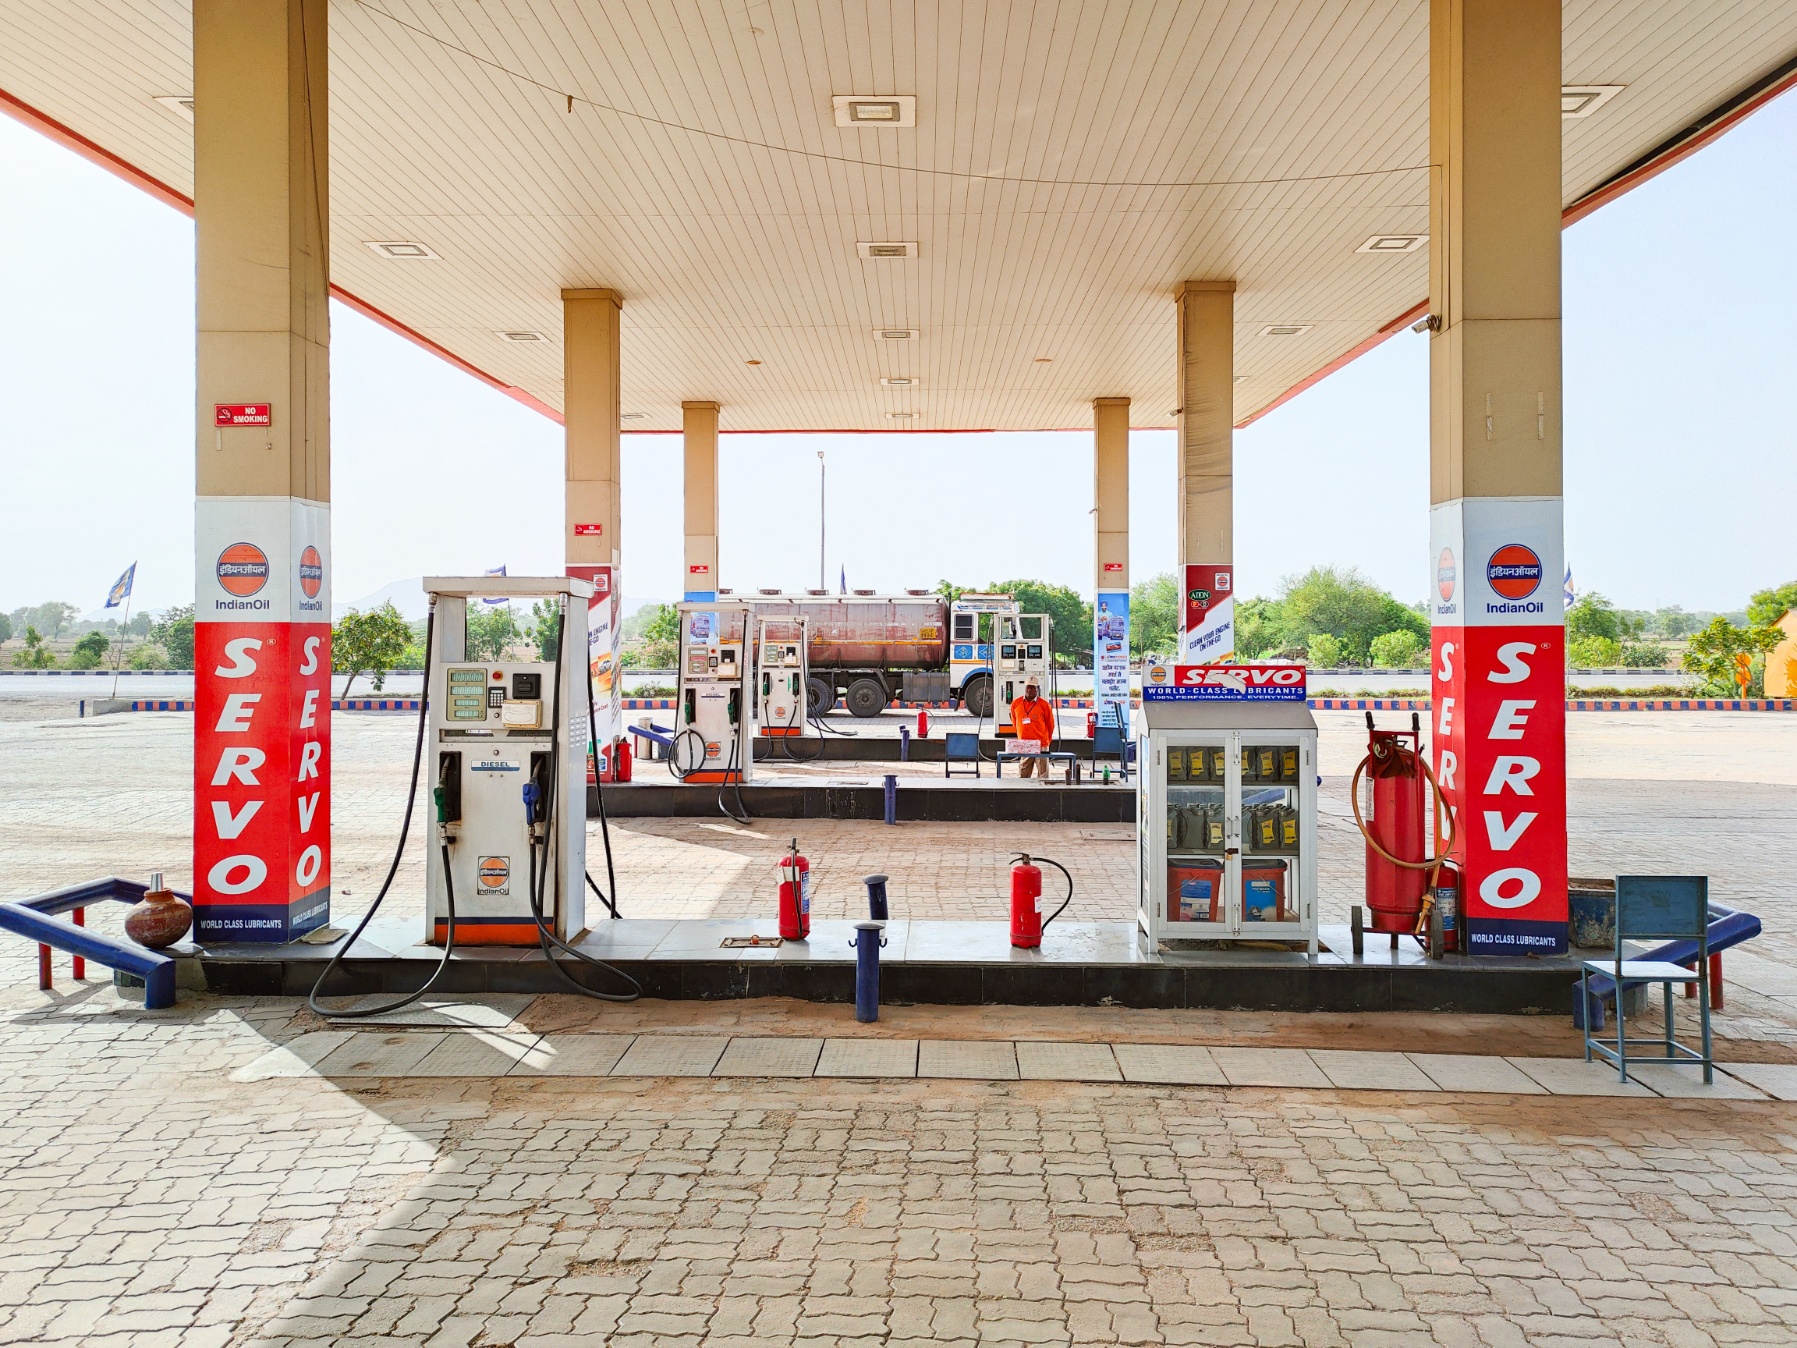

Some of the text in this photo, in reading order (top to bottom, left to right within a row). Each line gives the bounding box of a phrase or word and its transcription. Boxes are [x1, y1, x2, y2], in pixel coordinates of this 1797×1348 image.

[245, 407, 256, 415] NO
[233, 415, 267, 423] SMOKING
[219, 563, 267, 575] इंडियनऑयल
[1490, 566, 1539, 578] इंडियनऑयल
[215, 599, 270, 610] IndianOil
[299, 601, 323, 611] IndianOil
[1437, 604, 1456, 614] IndianOil
[1486, 602, 1544, 613] IndianOil
[1147, 687, 1303, 695] WORLD-CLASS LBRICANTS
[207, 637, 268, 895] SERVO
[296, 636, 322, 887] SERVO
[1479, 641, 1541, 909] SERVO
[201, 919, 282, 929] WORLD CLASS LUBRICANTS
[1471, 933, 1556, 947] WORLD CLASS LUBRICANTS
